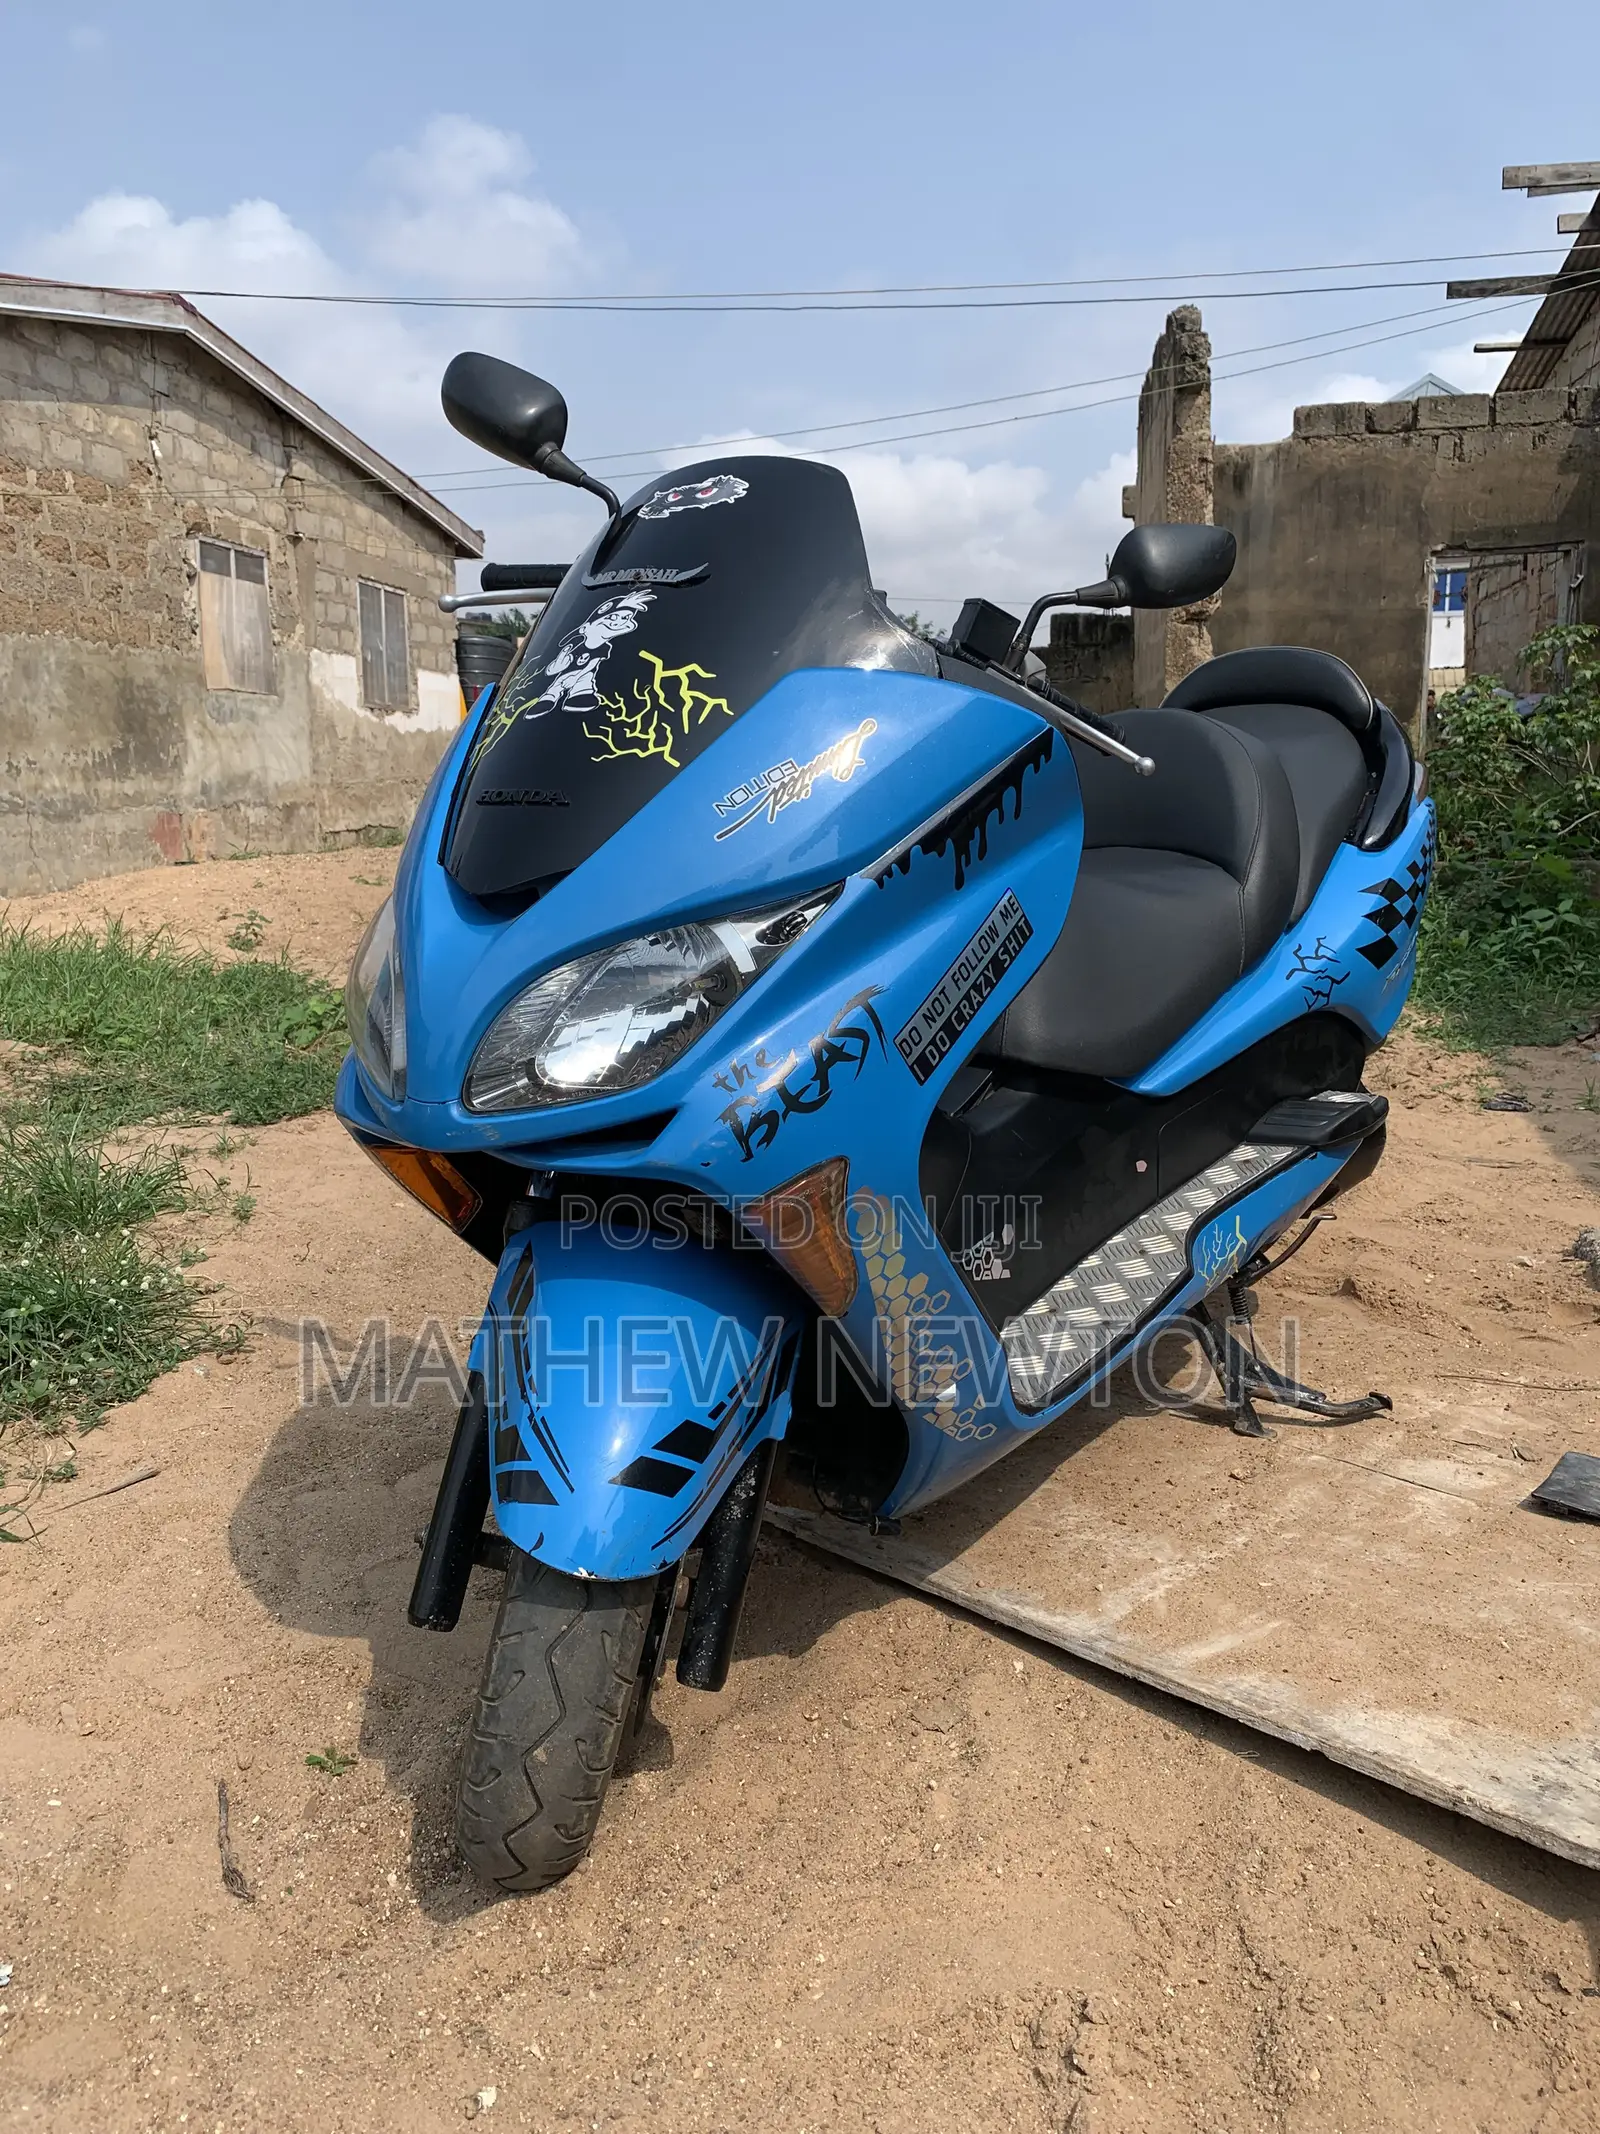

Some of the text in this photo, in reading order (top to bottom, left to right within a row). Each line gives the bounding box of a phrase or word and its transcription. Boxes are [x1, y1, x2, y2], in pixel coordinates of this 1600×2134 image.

[478, 787, 570, 806] HONDA
[713, 758, 800, 818] EDITION
[898, 894, 1019, 1060] DO NOT FOLLOW ME
[913, 916, 1031, 1081] I DO CRAZY SHIT
